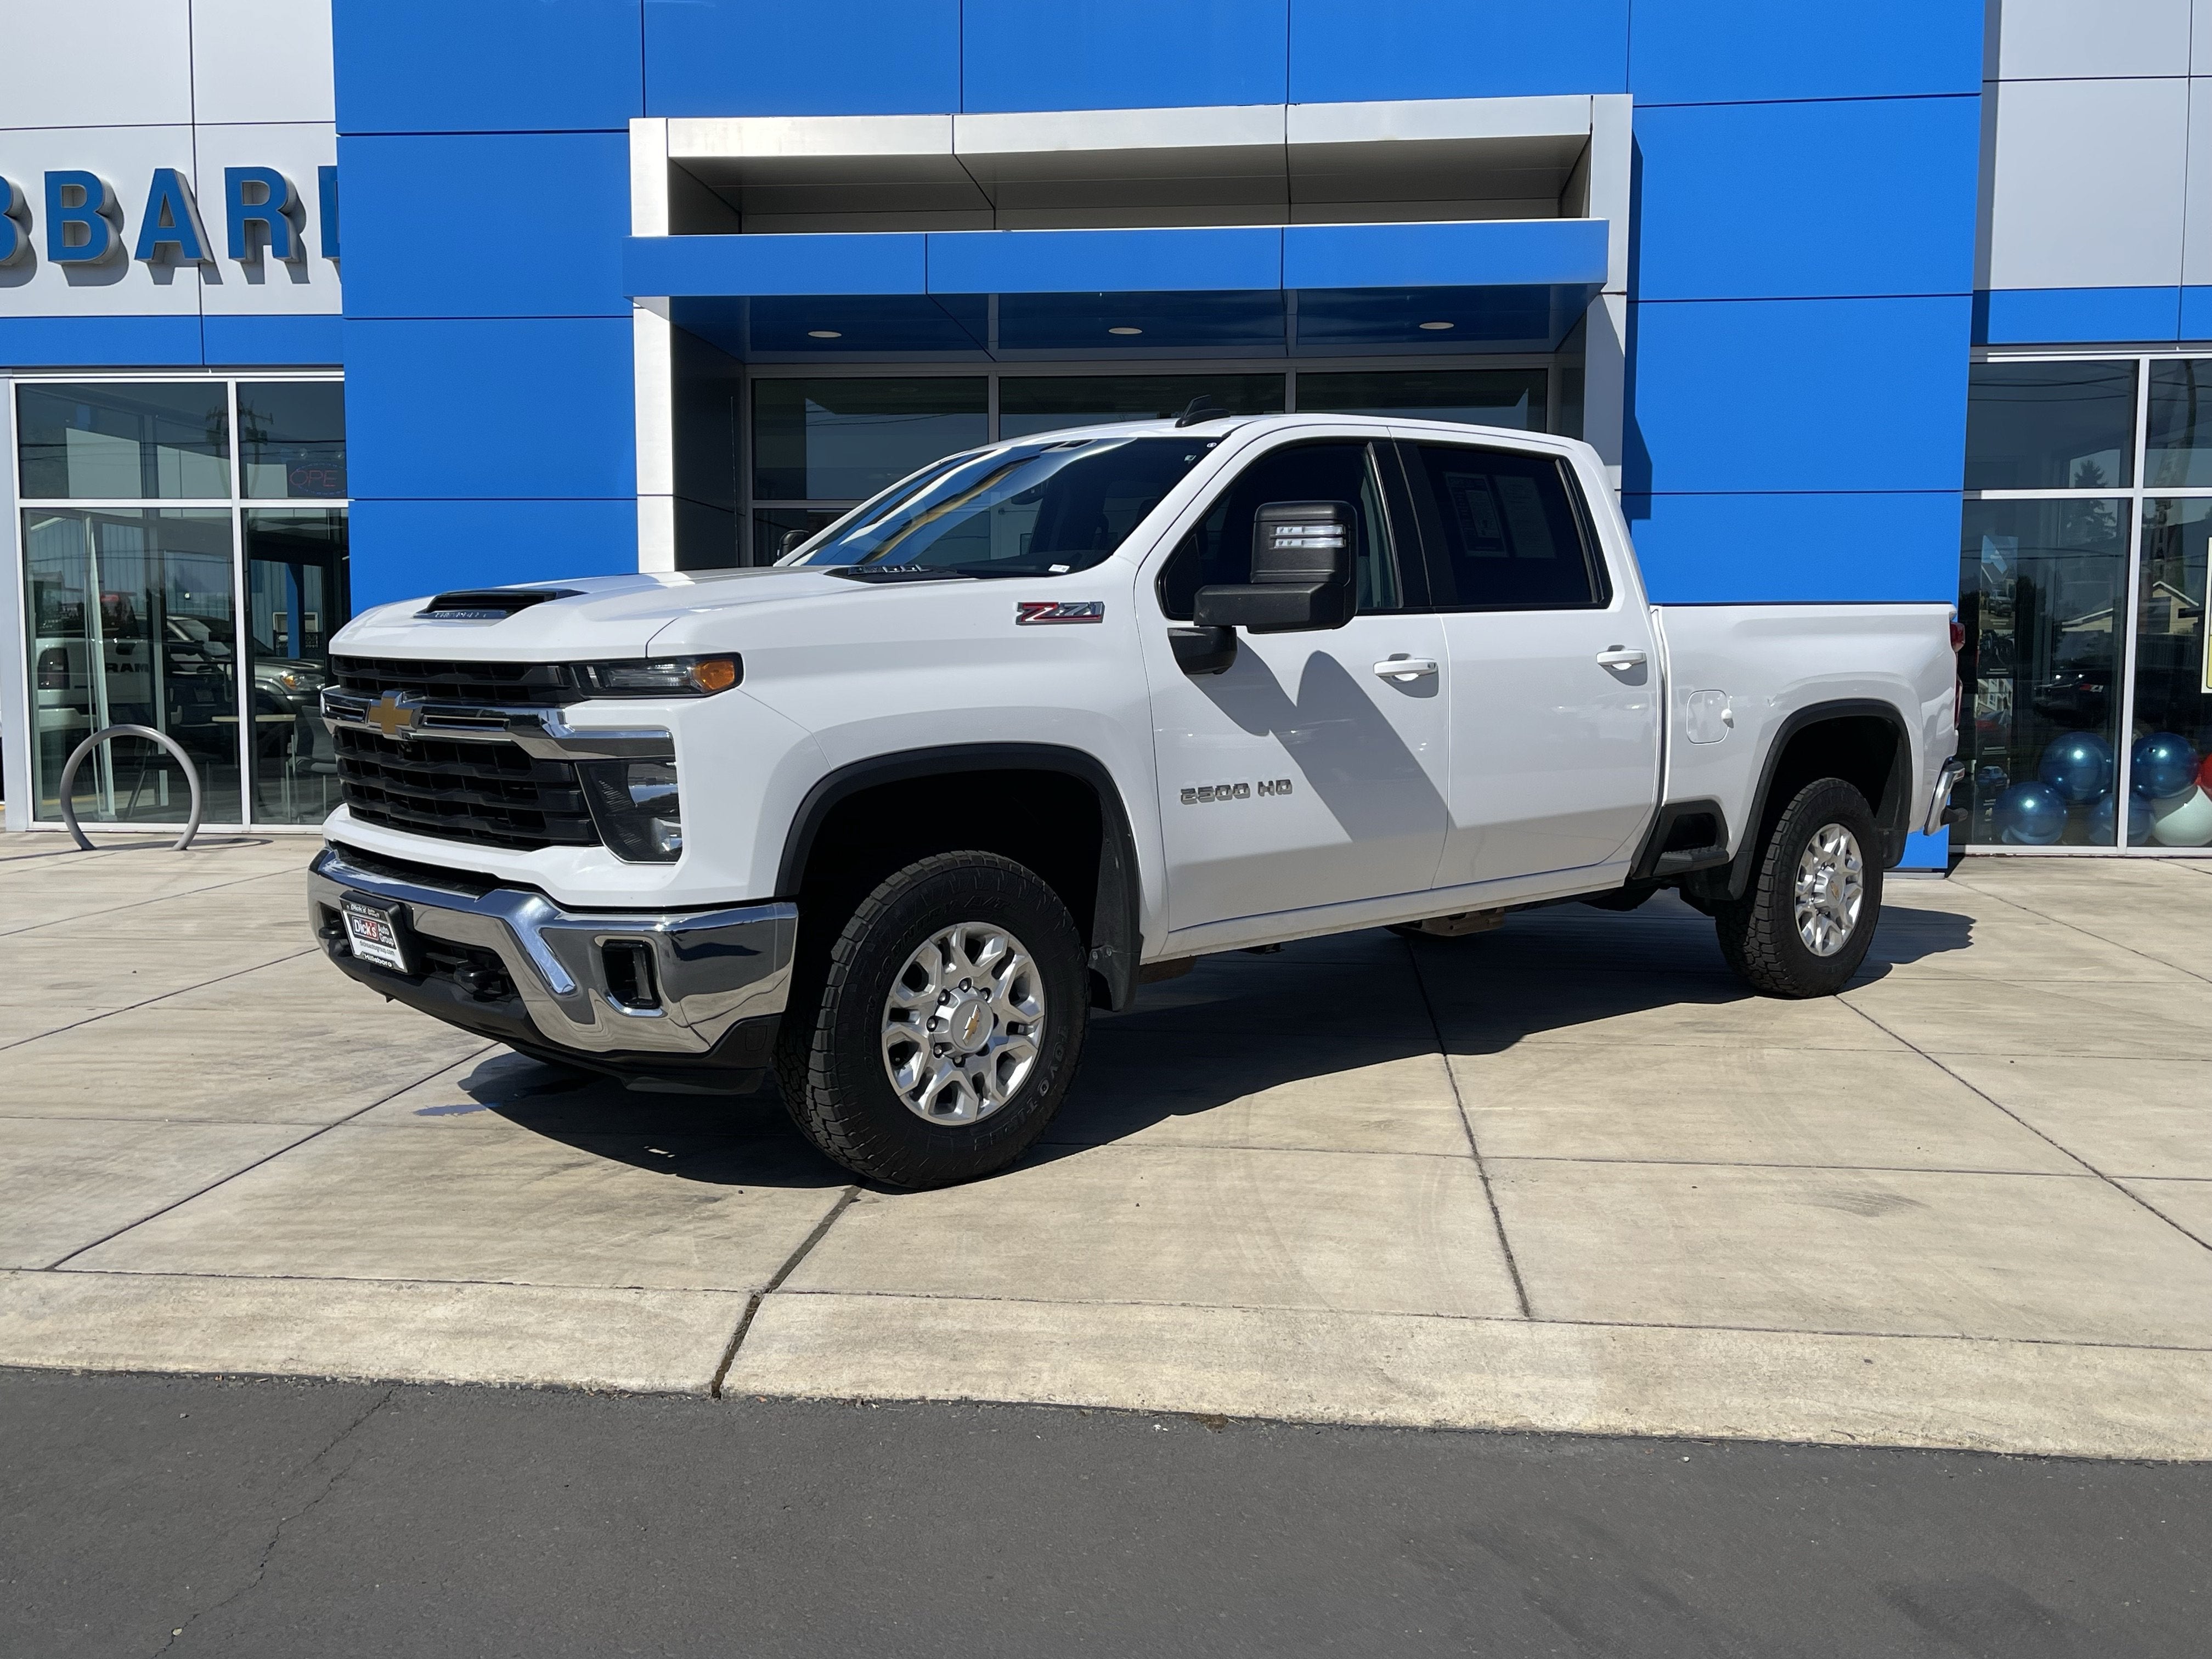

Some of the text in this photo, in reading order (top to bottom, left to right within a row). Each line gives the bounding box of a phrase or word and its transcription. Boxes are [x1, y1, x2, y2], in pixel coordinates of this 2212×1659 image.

[0, 166, 339, 262] BAR
[1016, 601, 1105, 626] Z71
[105, 663, 149, 673] RAM
[1181, 779, 1293, 805] 2500 HD
[353, 919, 377, 938] Dick's
